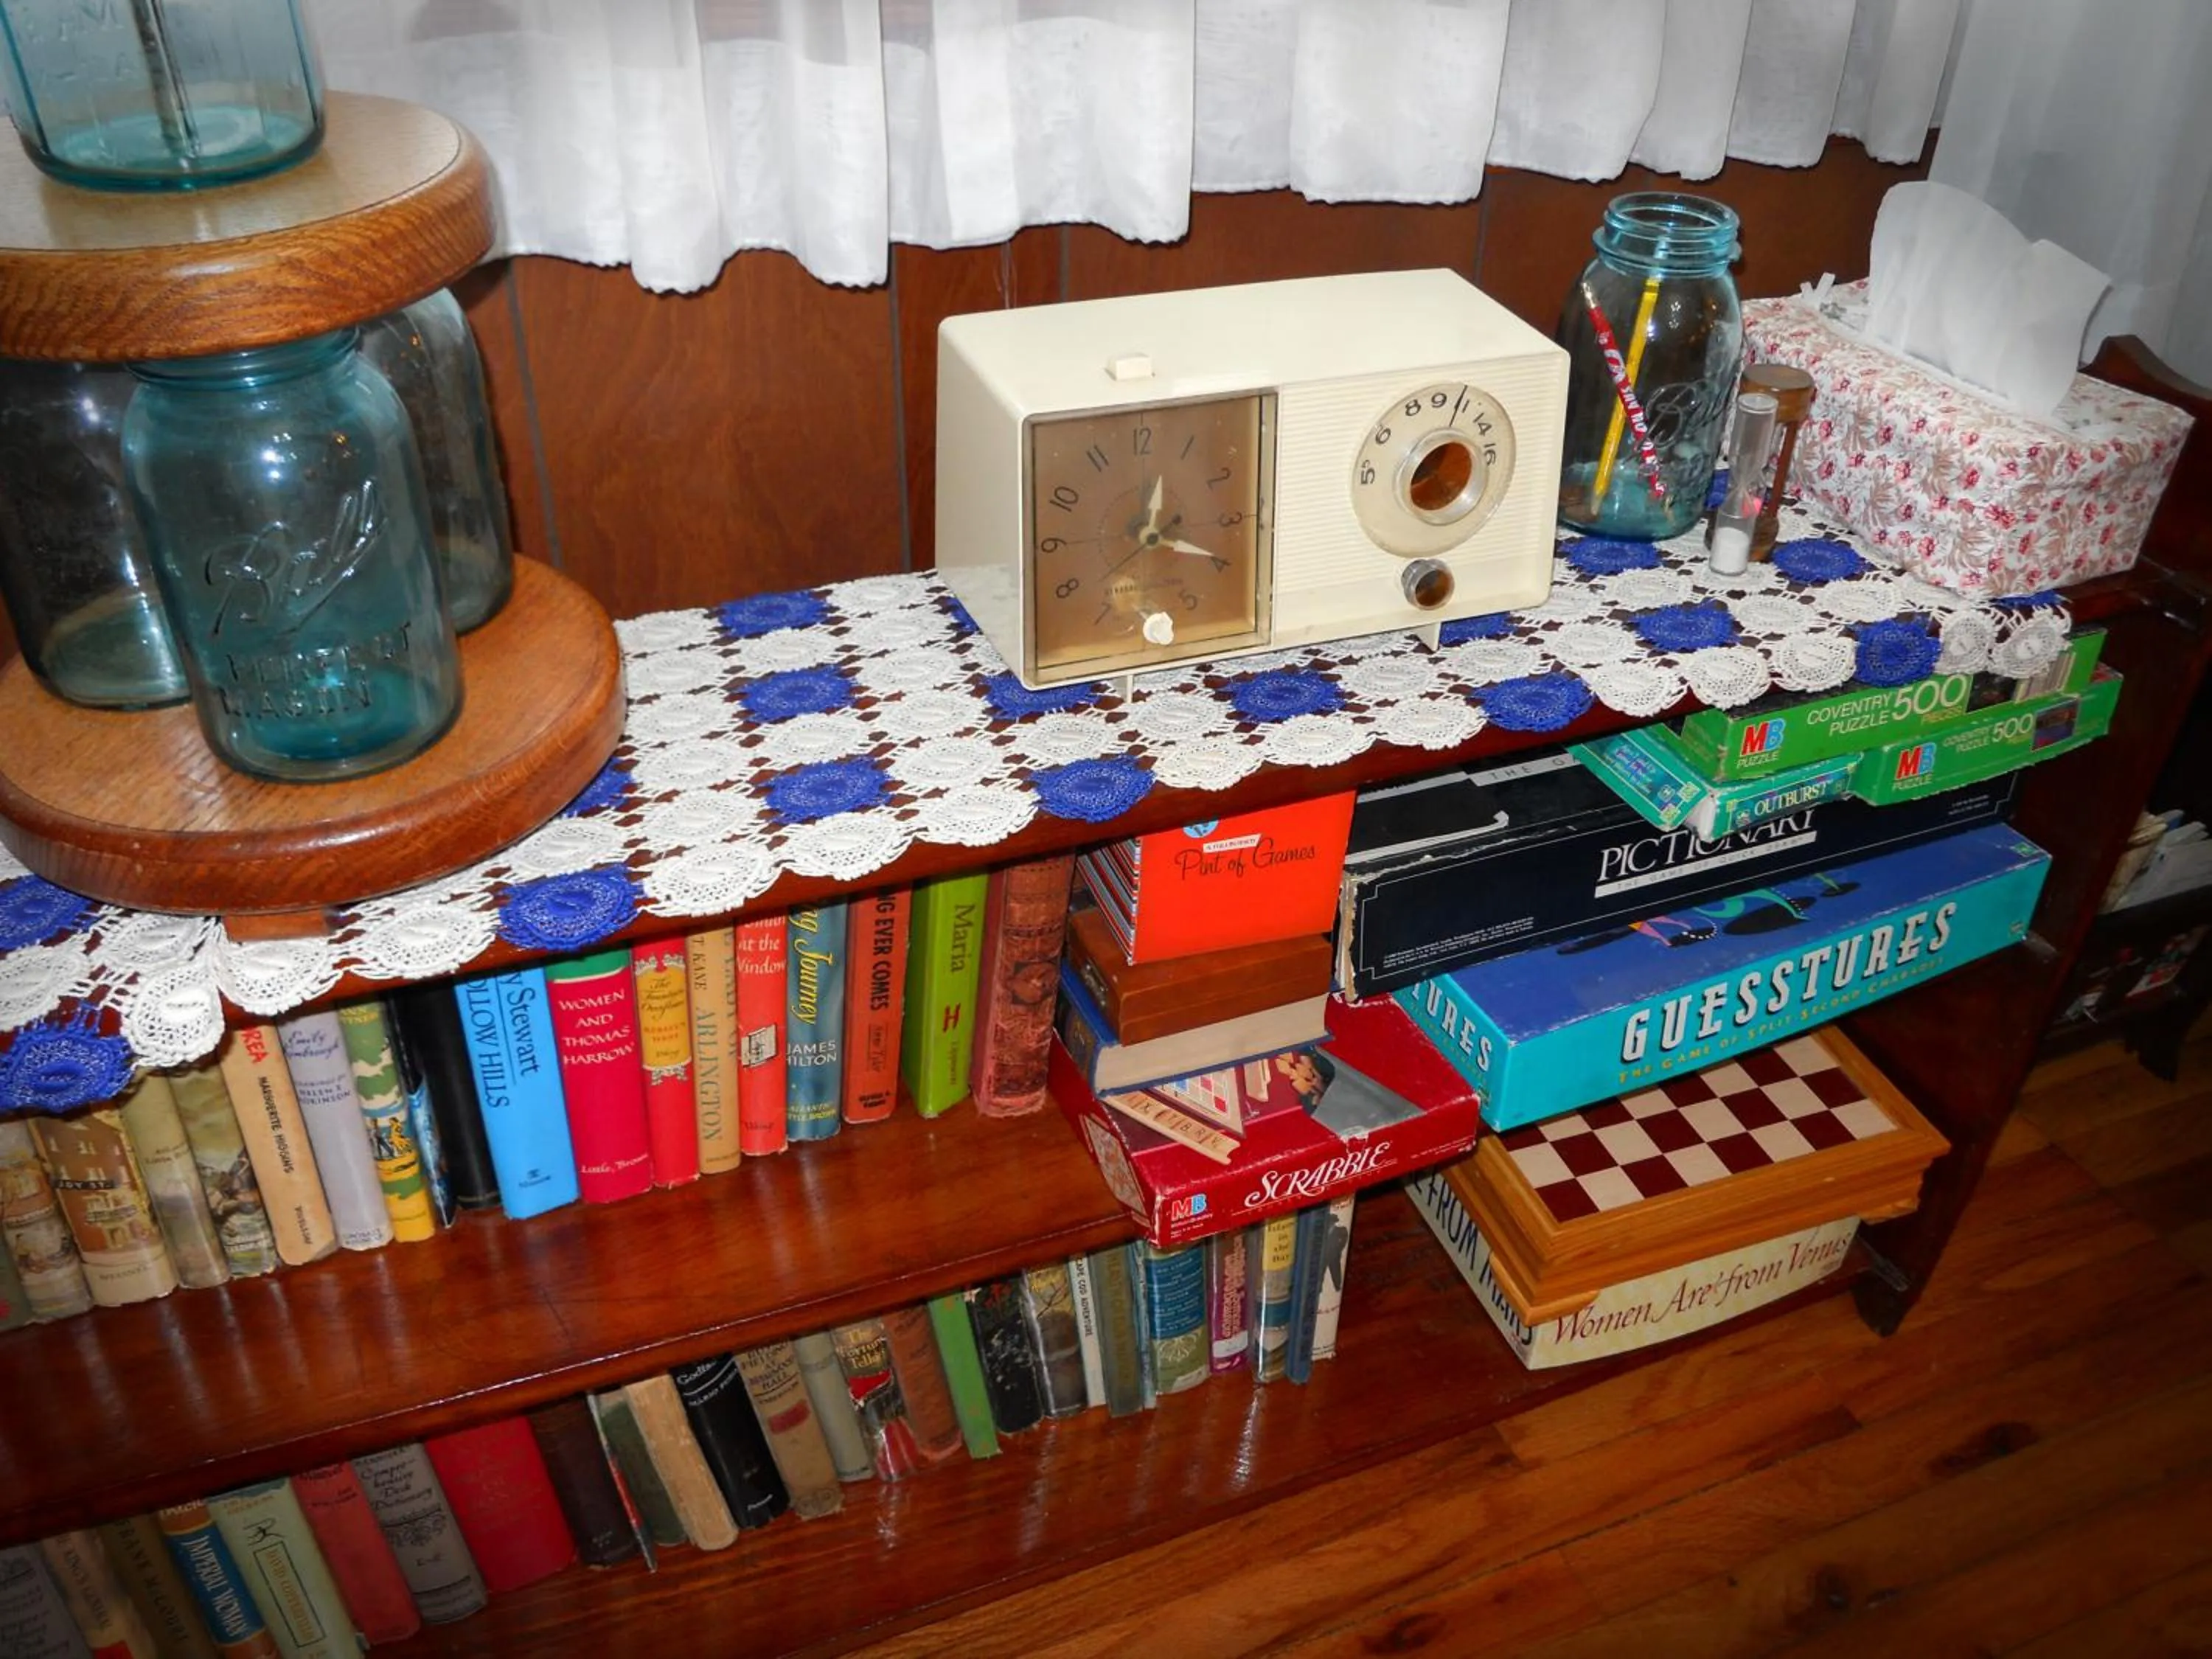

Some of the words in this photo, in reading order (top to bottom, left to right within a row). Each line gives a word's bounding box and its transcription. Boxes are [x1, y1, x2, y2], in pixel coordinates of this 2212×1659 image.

[1404, 398, 1422, 417] 8
[1430, 392, 1447, 408] 9
[1374, 425, 1392, 445] 6
[1472, 412, 1492, 437] 14
[1132, 427, 1152, 456] 12
[1181, 434, 1194, 460] 1
[1483, 442, 1497, 466] 16
[1085, 445, 1110, 473] 11
[1207, 467, 1232, 490] 2
[1049, 485, 1080, 512] 10
[1220, 511, 1243, 527] 3
[205, 479, 389, 635] Ball
[1040, 537, 1068, 554] 9
[1209, 554, 1232, 573] 4
[1055, 577, 1080, 599] 8
[1178, 589, 1198, 611] 5
[1806, 692, 1893, 726] COVENTRY
[1891, 674, 1969, 722] 500
[1740, 717, 1787, 756] MB
[1829, 710, 1891, 737] PUZZLE
[1992, 713, 2034, 743] 500
[1491, 765, 1531, 780] THE
[1736, 751, 1779, 769] PUZZLE
[1895, 742, 1937, 780] MB
[1753, 782, 1829, 816] OUTBURST
[1253, 837, 1316, 869] Games
[758, 933, 780, 951] the
[873, 918, 895, 956] EVER
[950, 902, 976, 974] Maria
[692, 953, 708, 991] KANE
[790, 938, 834, 1025] Journey
[1621, 902, 1958, 1064] GUESSTURES
[558, 987, 625, 1012] WOMEN
[870, 960, 892, 1012] COMES
[506, 987, 541, 1077] Stewart
[574, 1013, 614, 1029] AND
[562, 1025, 631, 1048] THOMAS
[786, 1039, 837, 1055] JAMES
[563, 1040, 636, 1065] HARROW
[1661, 1044, 1711, 1070] GAME
[478, 1051, 510, 1109] HILLS
[695, 1006, 723, 1142] ARLINGTON
[259, 1075, 283, 1134] MARGUERITE
[274, 1132, 295, 1175] HIGGINS
[1244, 1141, 1392, 1208] SCRABBLE
[1171, 1193, 1208, 1221] MB
[1554, 1301, 1653, 1346] Women
[1653, 1278, 1711, 1324] Are
[1718, 1259, 1783, 1308] from
[1788, 1232, 1851, 1275] Venus
[181, 1534, 229, 1592] IMPERIAL
[212, 1589, 251, 1638] WOMAN
